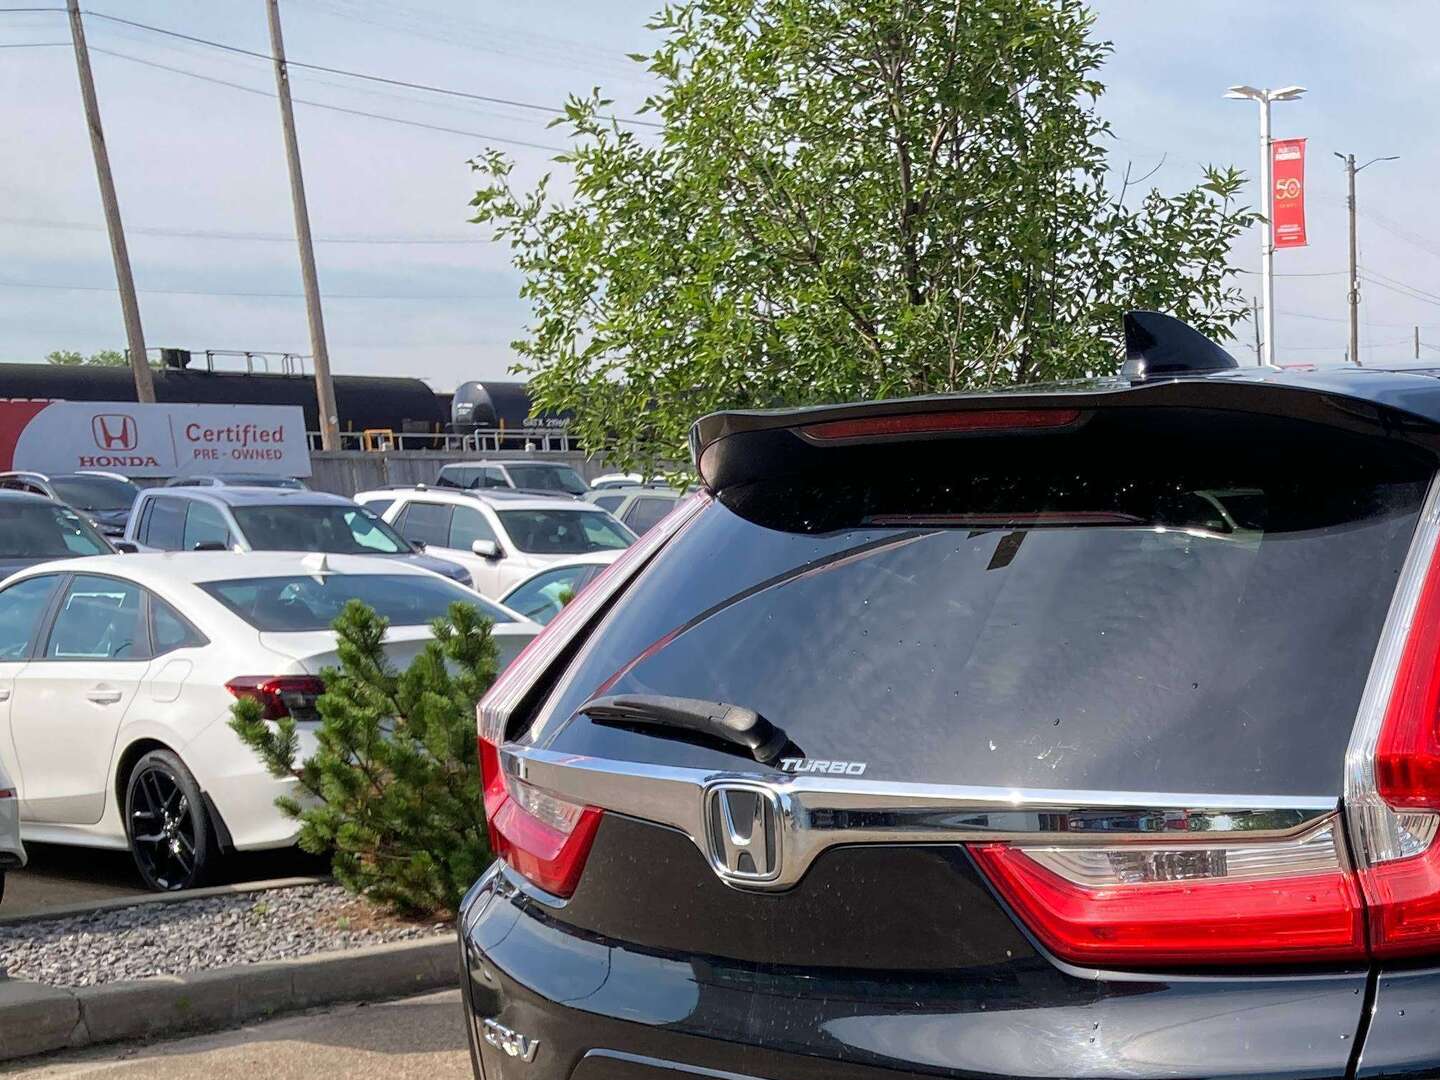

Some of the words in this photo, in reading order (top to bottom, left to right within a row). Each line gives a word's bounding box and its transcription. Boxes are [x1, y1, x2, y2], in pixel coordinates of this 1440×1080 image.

[1276, 178, 1300, 200] 50
[186, 423, 284, 449] Certified
[79, 456, 160, 467] HONDA
[194, 449, 217, 460] PRE
[231, 449, 283, 460] OWNED
[780, 758, 867, 776] TURBO
